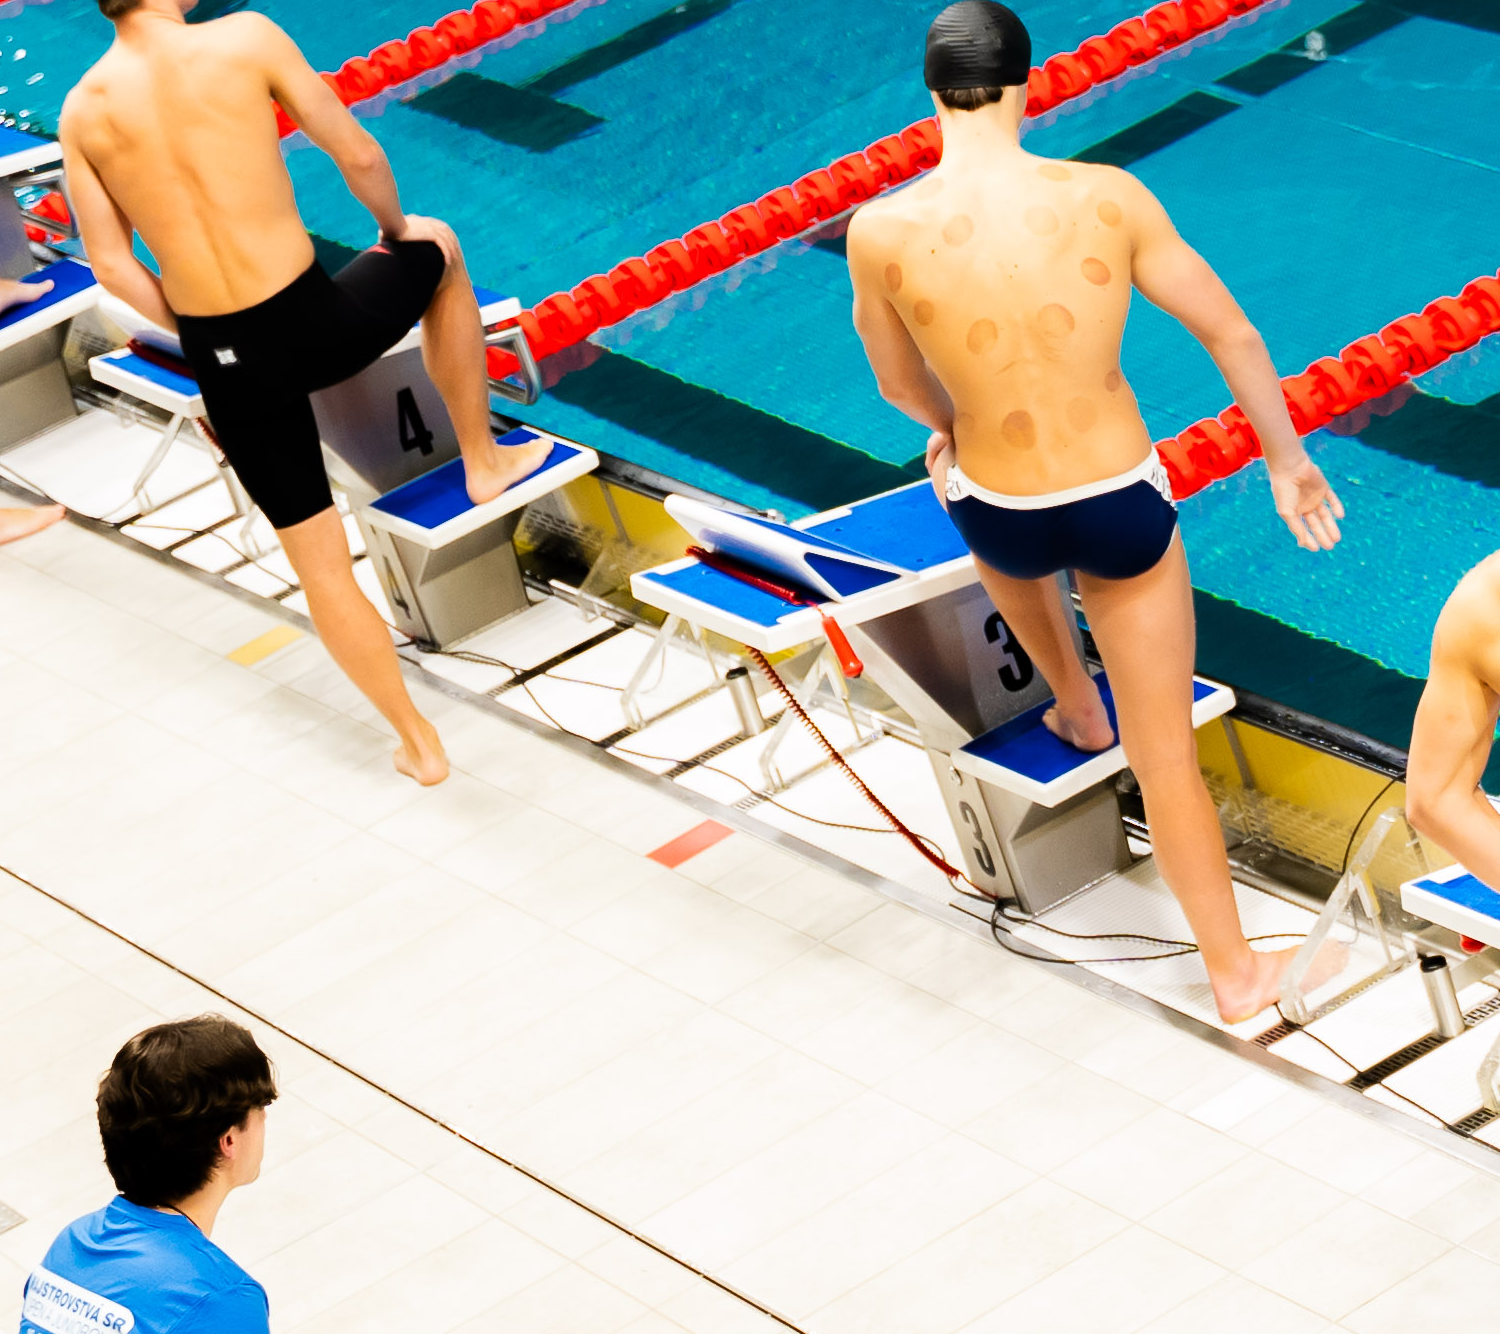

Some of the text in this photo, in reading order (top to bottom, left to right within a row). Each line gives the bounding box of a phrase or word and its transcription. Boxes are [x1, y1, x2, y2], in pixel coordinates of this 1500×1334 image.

[396, 386, 434, 457] 4
[983, 610, 1034, 692] 3
[960, 801, 996, 878] 3
[103, 1312, 126, 1332] SR
